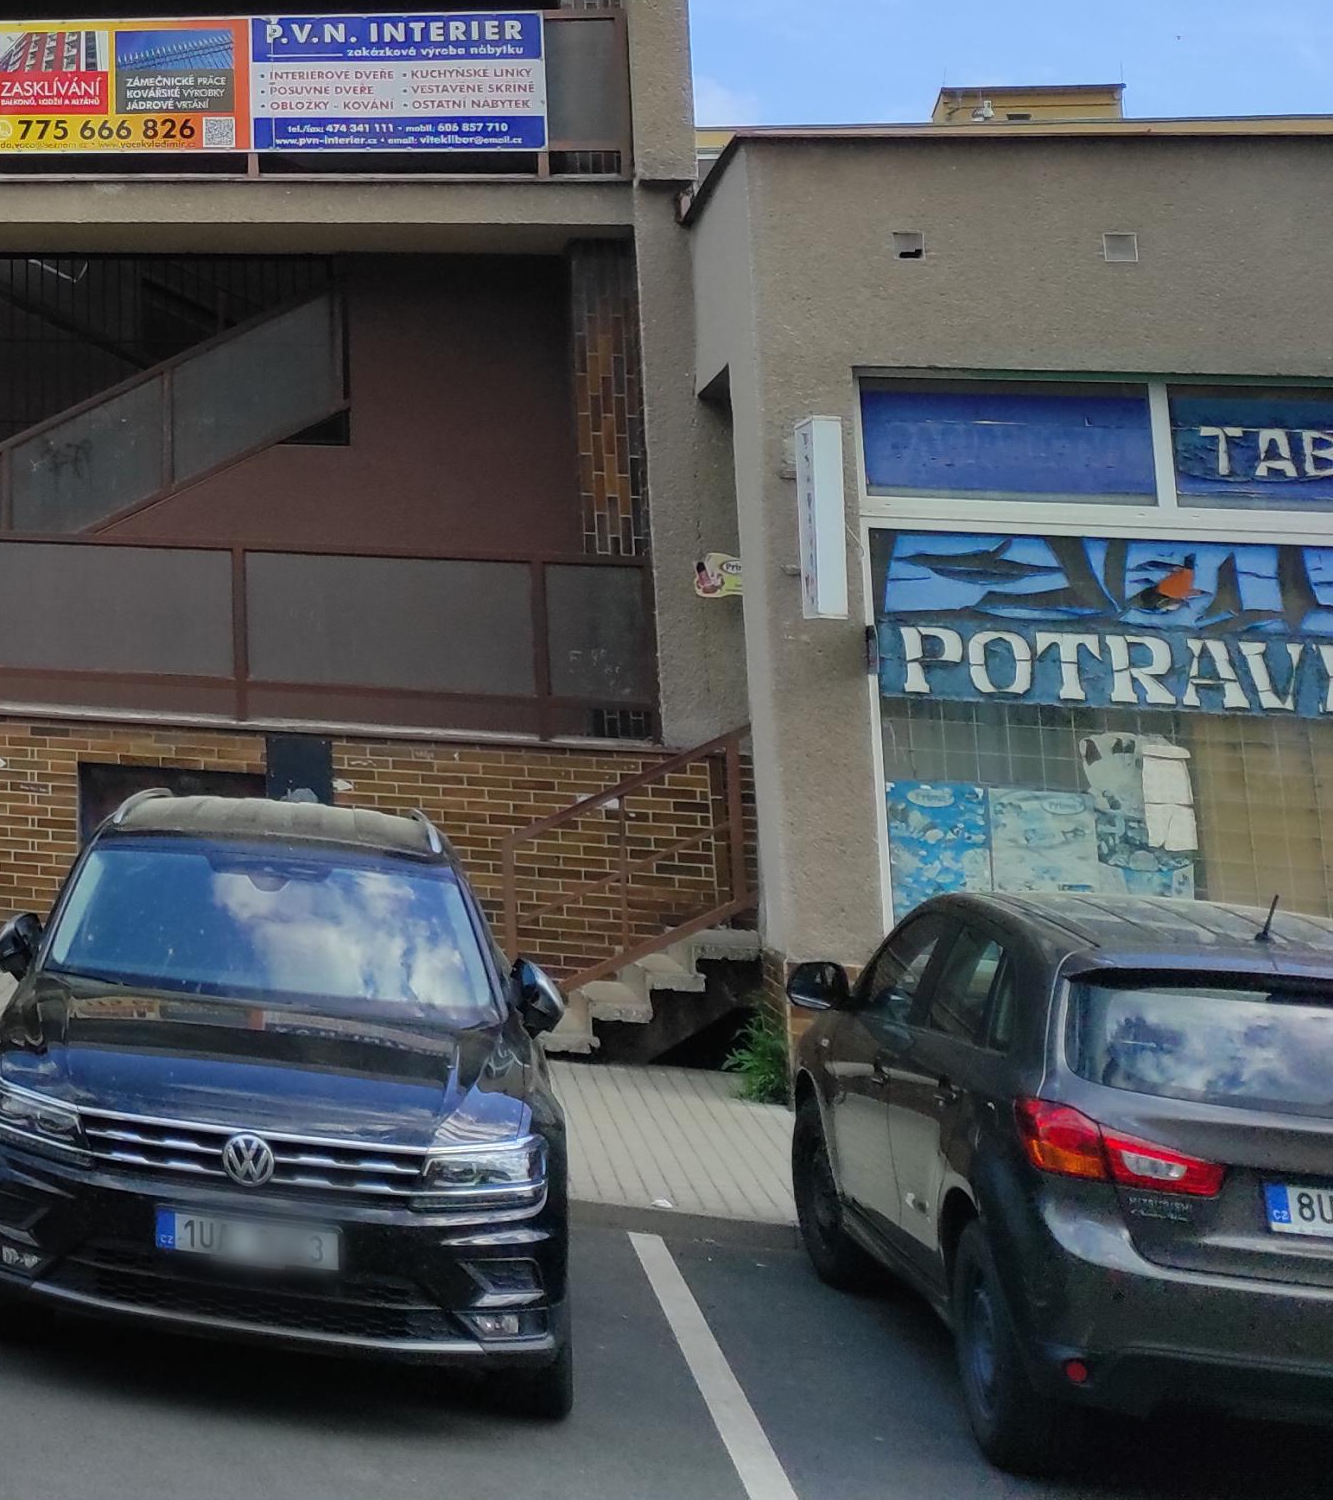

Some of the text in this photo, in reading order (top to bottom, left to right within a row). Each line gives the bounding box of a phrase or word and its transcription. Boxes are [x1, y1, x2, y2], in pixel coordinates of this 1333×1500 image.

[267, 20, 523, 44] P.V.N. INTERIER
[347, 43, 524, 58] zakázková výroba nábytku
[354, 68, 394, 79] DVEŘE
[411, 66, 533, 79] KUCHYŇSKÉ LINKY
[0, 76, 101, 97] ZASKLÍVÁNÍ
[126, 74, 227, 87] ZÁMEČNICKÉ PRÁCE
[269, 83, 374, 95] POSUVNÉ DVEŘE
[126, 98, 209, 110] JÁDROVÉ VRTÁNÍ
[270, 99, 330, 110] OBLOŽKY
[343, 98, 394, 110] KOVÁNÍ
[412, 97, 531, 109] OSTATNÍ NÁBYTEK
[17, 118, 195, 140] 775 666 826
[326, 123, 347, 133] 474
[349, 123, 370, 133] 341
[374, 123, 394, 132] 111
[462, 122, 484, 132] 857
[487, 122, 508, 132] 710
[160, 1235, 174, 1244] CZ
